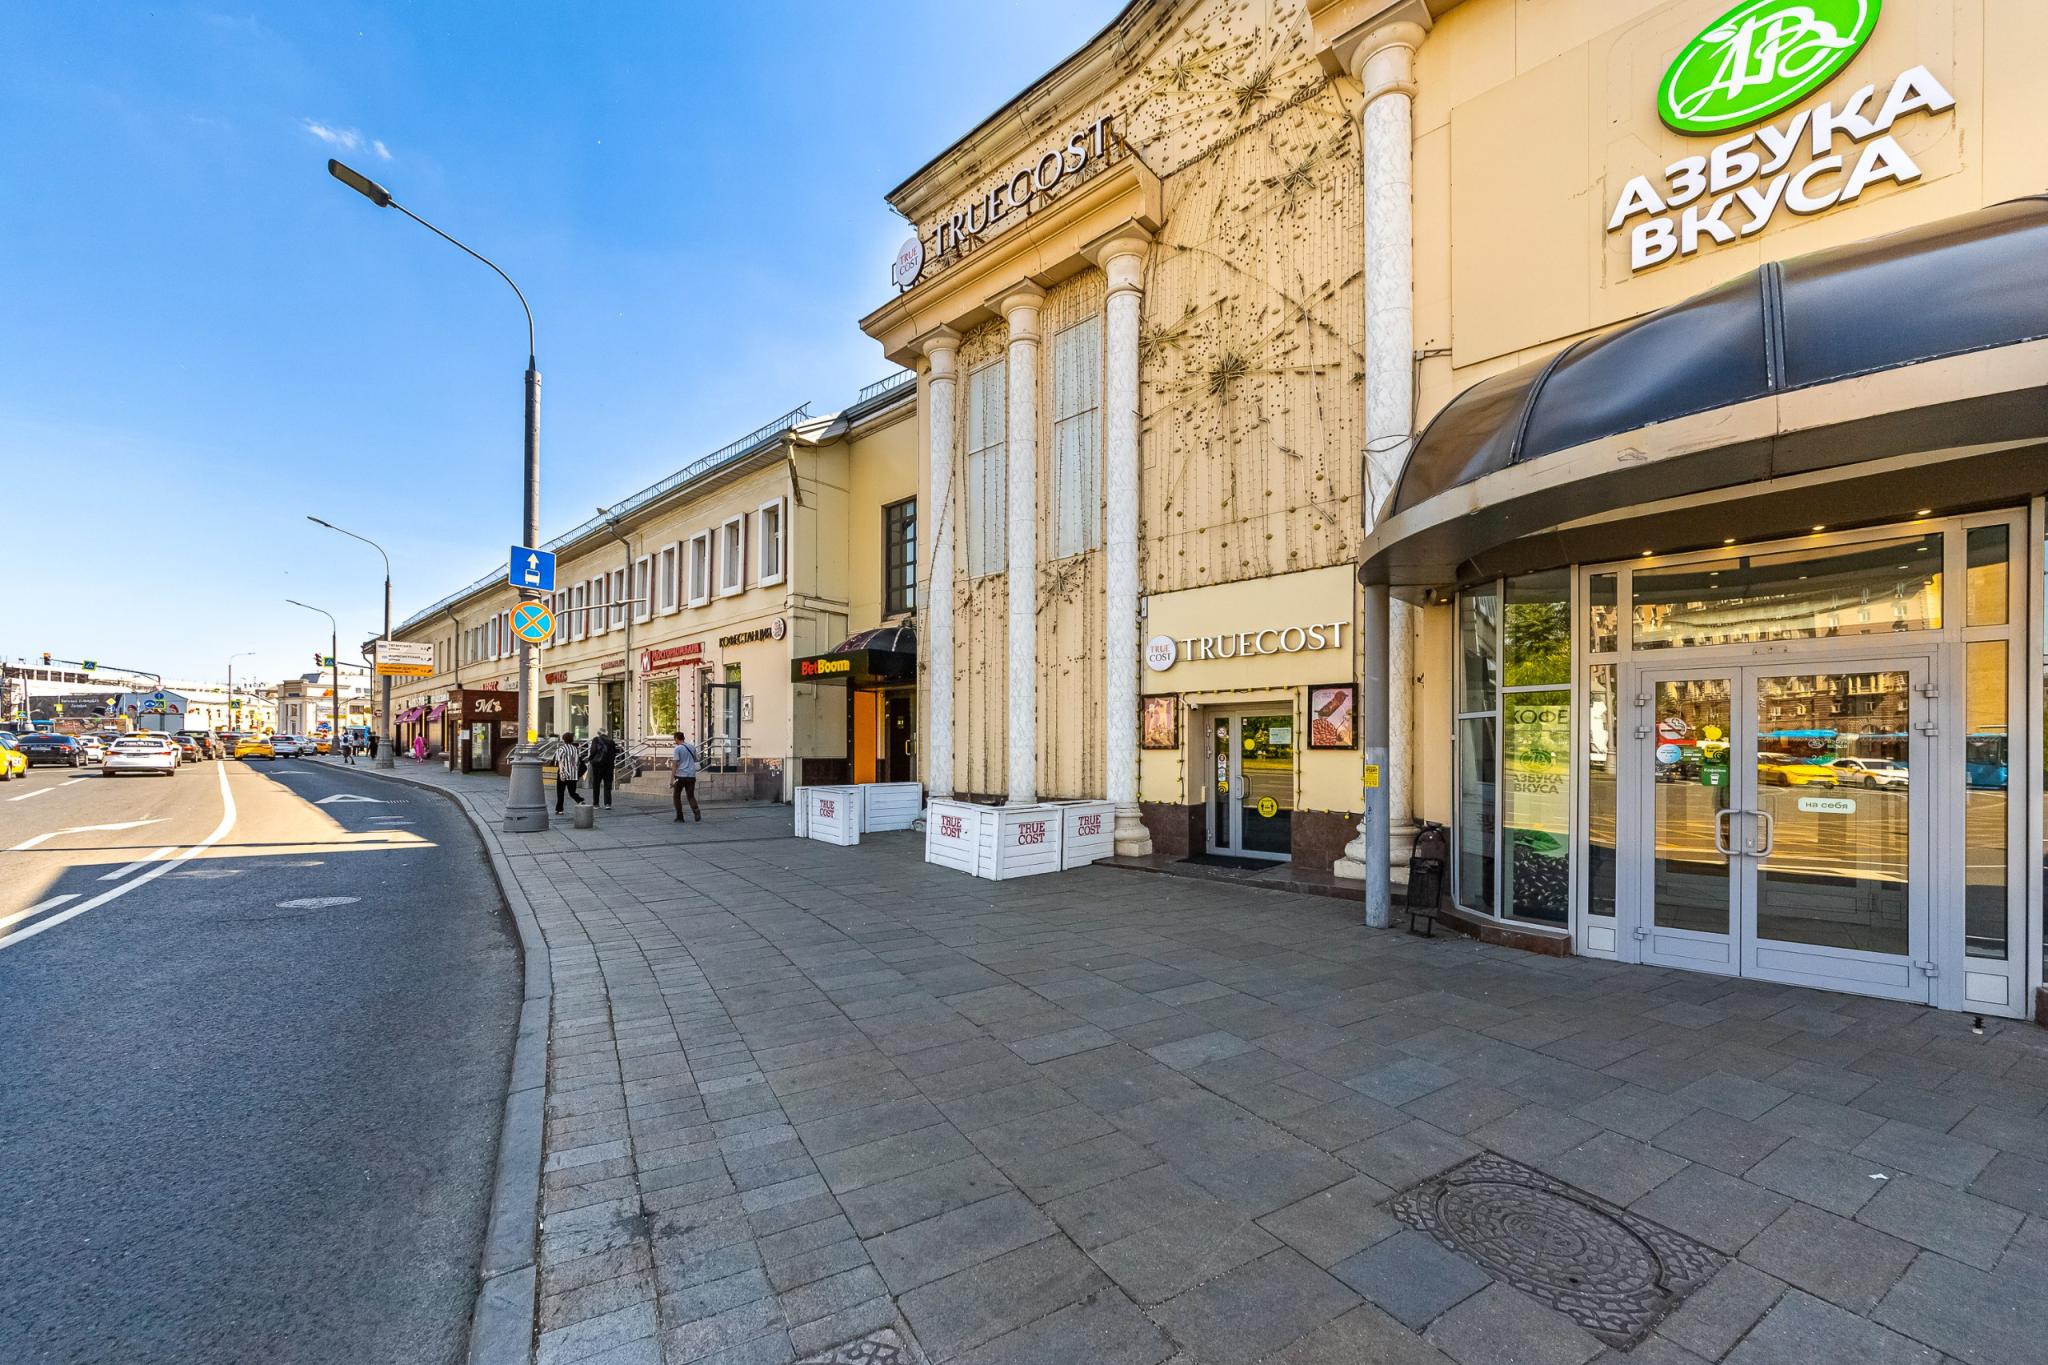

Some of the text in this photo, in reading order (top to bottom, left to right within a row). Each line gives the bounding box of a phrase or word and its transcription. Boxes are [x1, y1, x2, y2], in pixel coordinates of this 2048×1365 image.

[1607, 65, 1956, 234] АЗБУКА
[932, 113, 1113, 258] TRUECOST
[1631, 135, 1923, 274] ВКУСА
[900, 246, 918, 263] TRUE
[899, 258, 920, 276] COST
[1181, 621, 1350, 661] TRUECOST
[1150, 645, 1169, 653] TRUE
[1149, 653, 1171, 662] COST
[801, 659, 850, 676] BetBoom
[1513, 783, 1560, 795] ВКУСА
[819, 799, 835, 810] TRUE
[1820, 801, 1848, 809] себя
[819, 808, 835, 819] COST
[941, 815, 962, 828] TRUE
[1078, 815, 1101, 827] TRUE
[940, 826, 962, 839] COST
[1018, 822, 1046, 835] TRUE
[1078, 825, 1101, 837] COST
[1018, 833, 1046, 846] COST
